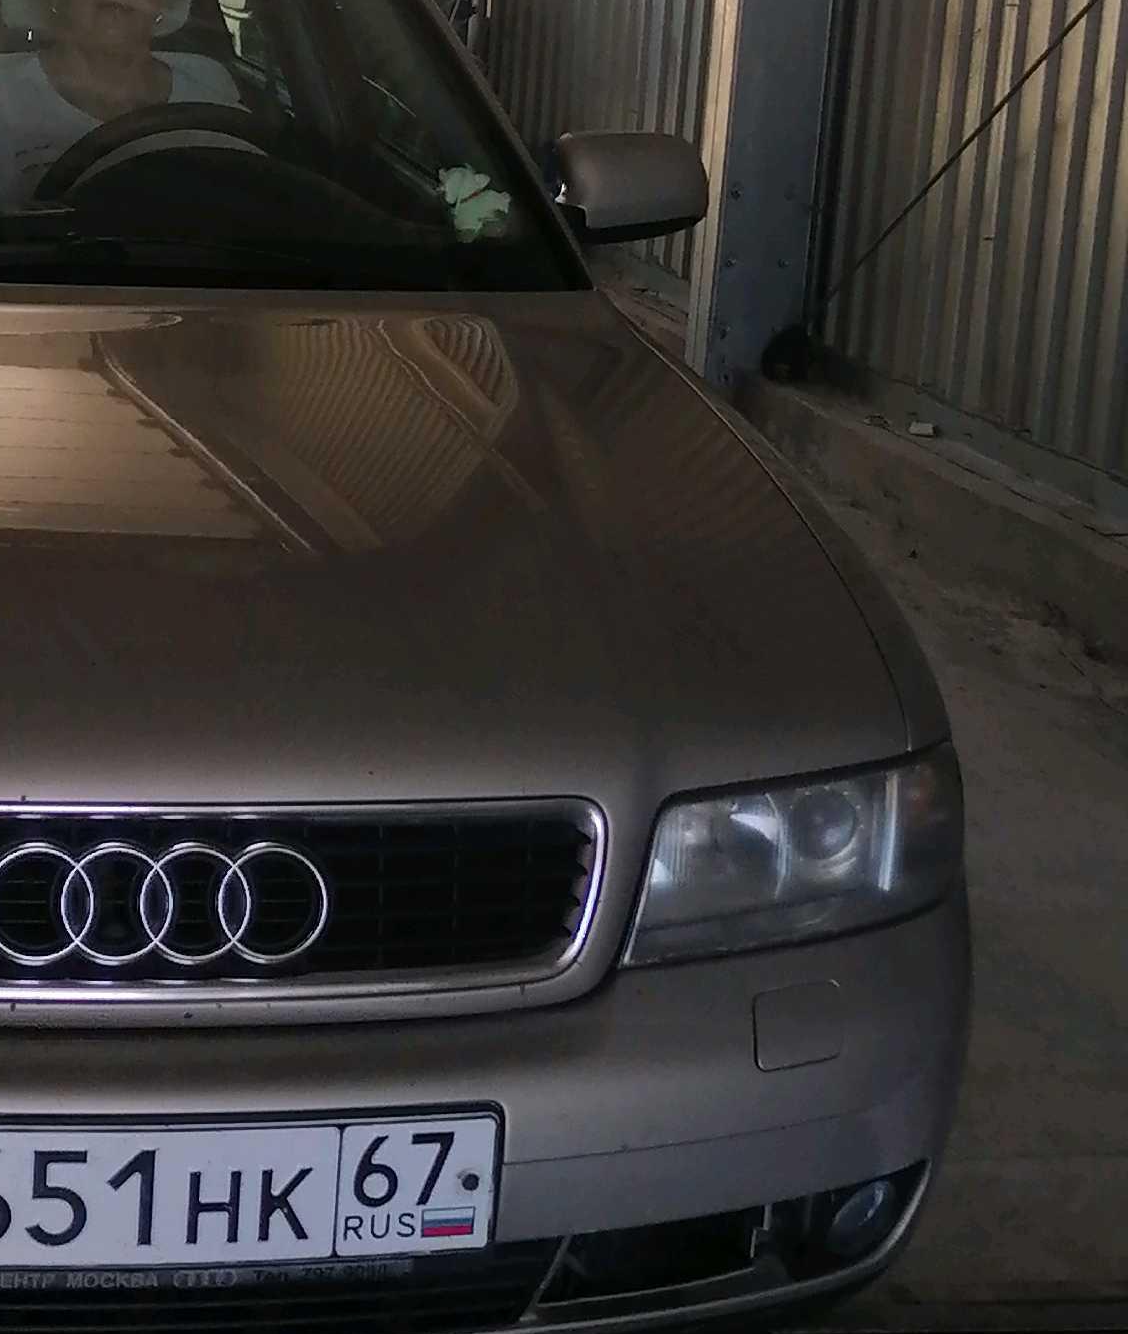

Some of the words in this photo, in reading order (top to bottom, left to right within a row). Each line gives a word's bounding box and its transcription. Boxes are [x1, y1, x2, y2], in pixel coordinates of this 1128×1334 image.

[353, 1132, 455, 1207] 67
[343, 1212, 416, 1241] RUS
[66, 1269, 160, 1289] МОСКВА
